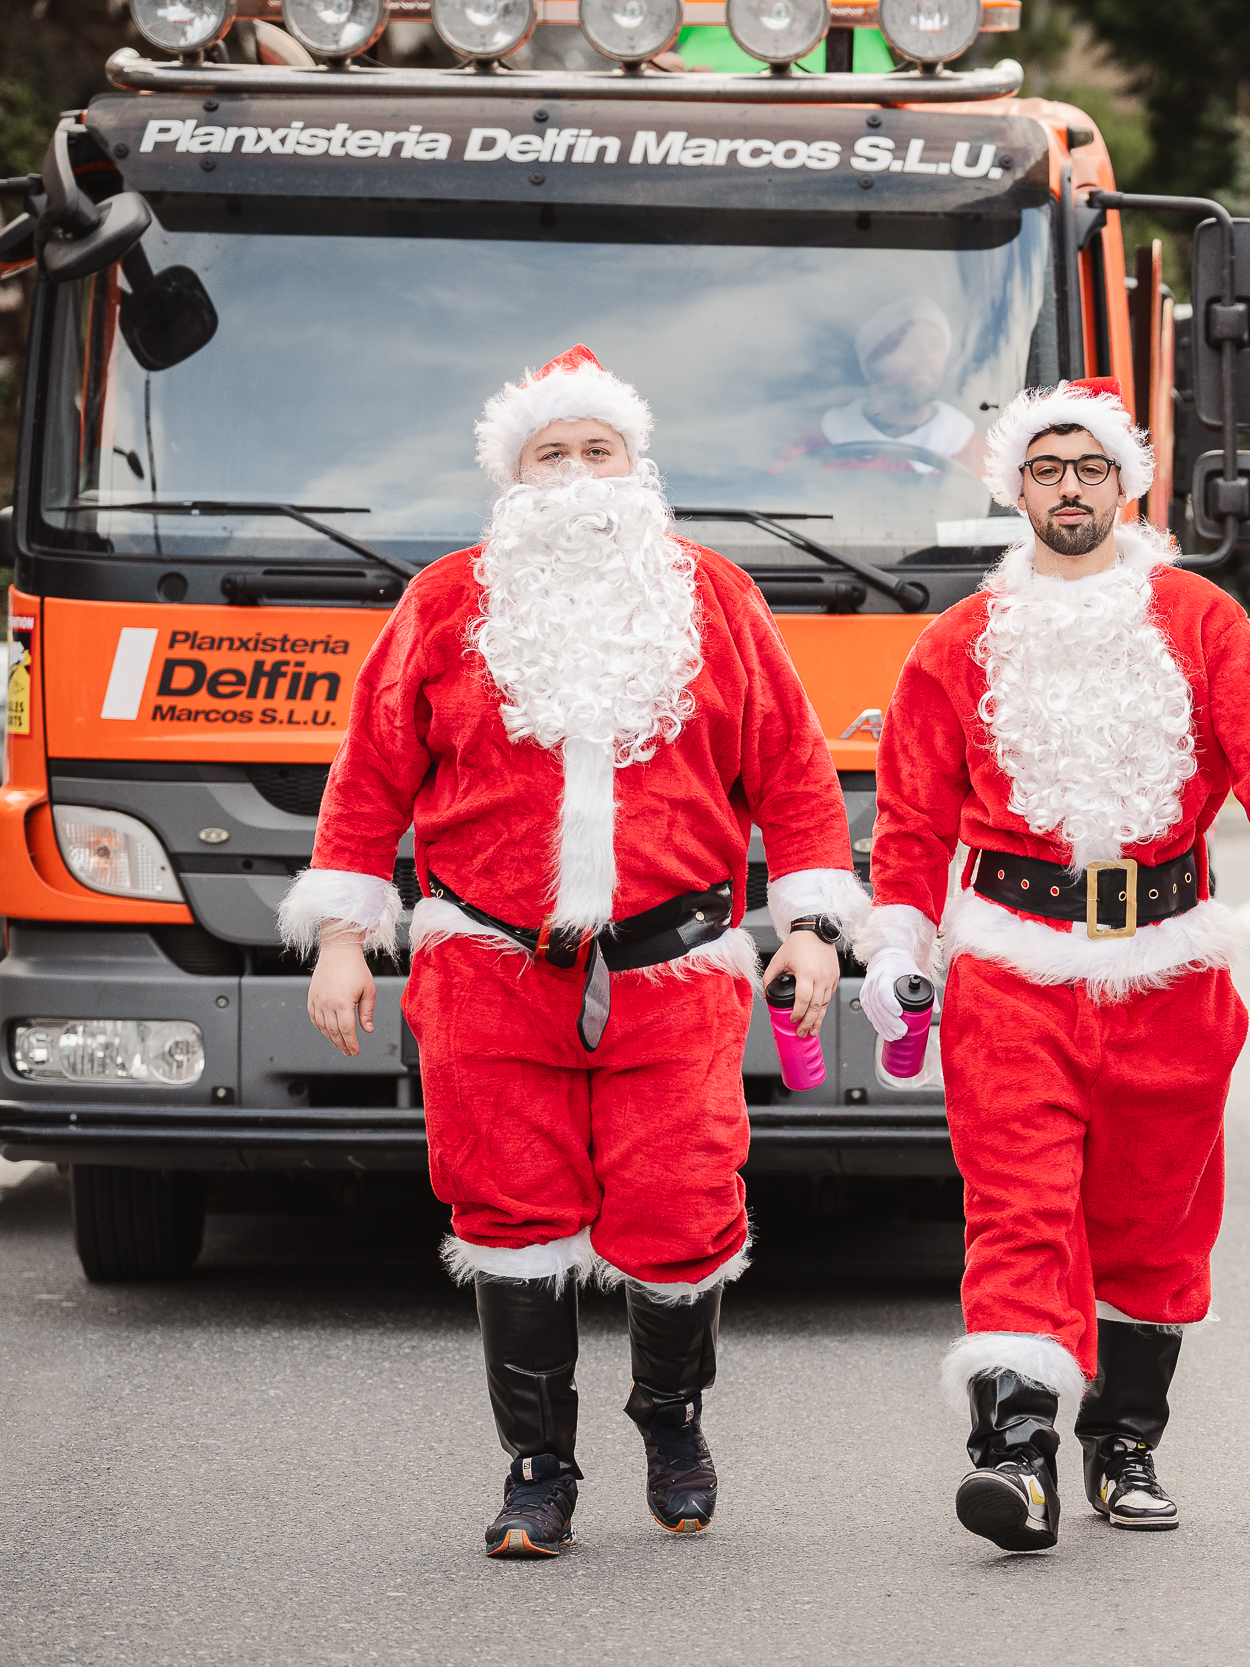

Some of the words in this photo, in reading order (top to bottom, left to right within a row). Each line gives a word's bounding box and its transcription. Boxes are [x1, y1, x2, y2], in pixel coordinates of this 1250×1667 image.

[139, 119, 453, 160] Planxisteria
[463, 127, 622, 164] Delfin
[628, 130, 842, 170] Marcos
[849, 135, 1004, 180] S.L.U.
[168, 630, 350, 655] Planxisteria
[156, 658, 341, 702] Delfin
[151, 704, 254, 724] Marcos
[260, 708, 337, 726] S.L.U.
